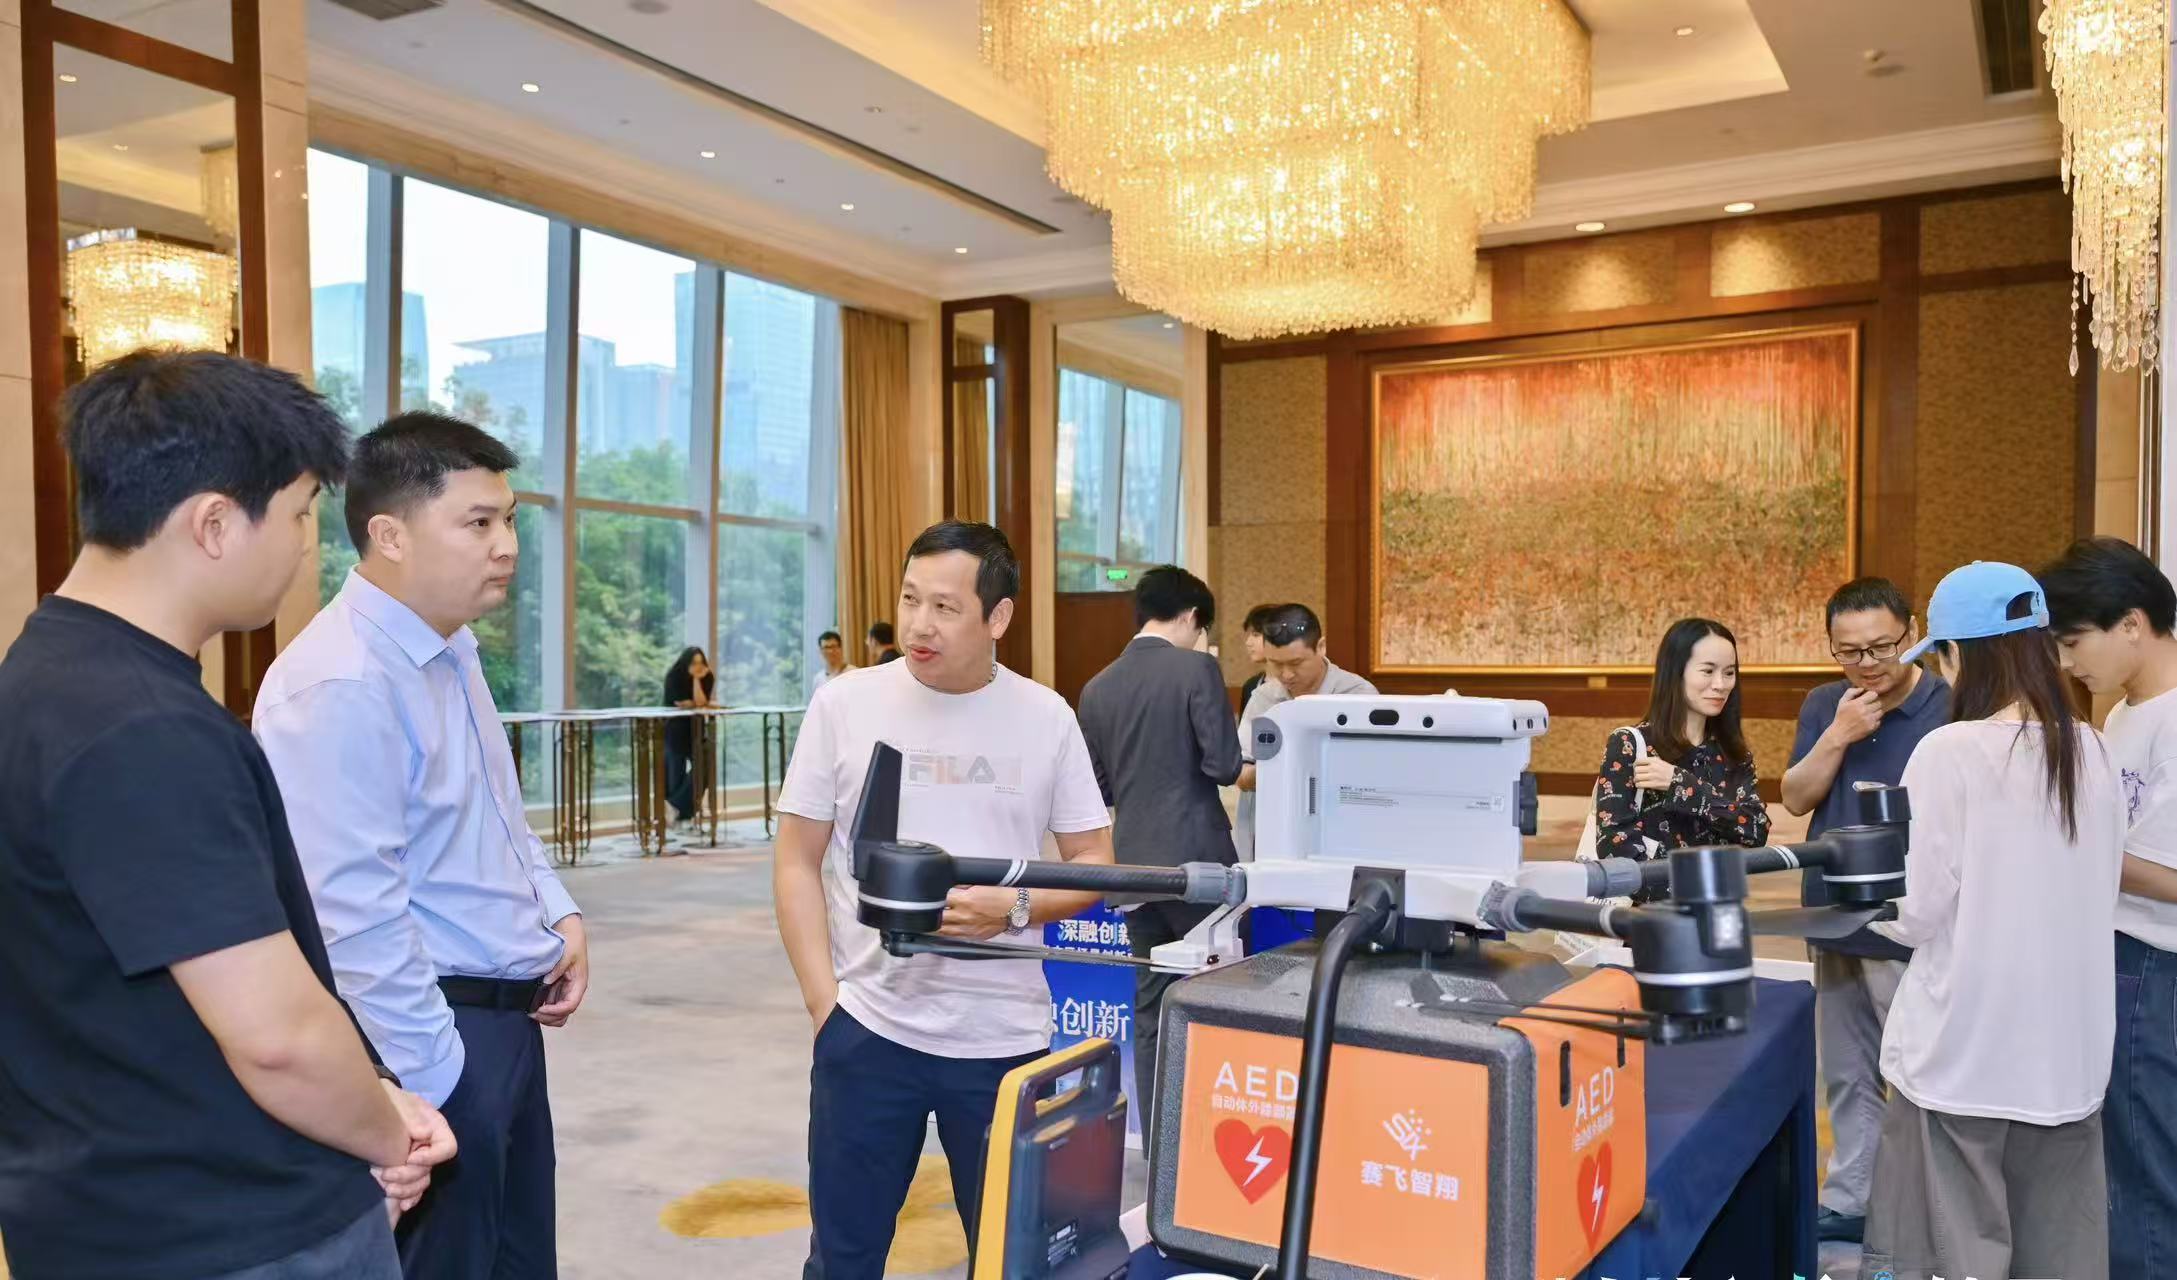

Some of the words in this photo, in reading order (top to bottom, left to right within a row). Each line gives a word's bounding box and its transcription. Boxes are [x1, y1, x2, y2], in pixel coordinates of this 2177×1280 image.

[1050, 996, 1131, 1041] 创新
[1213, 1061, 1300, 1102] AED
[1575, 1066, 1614, 1127] AED
[1361, 1160, 1460, 1201] 赛飞智翔
